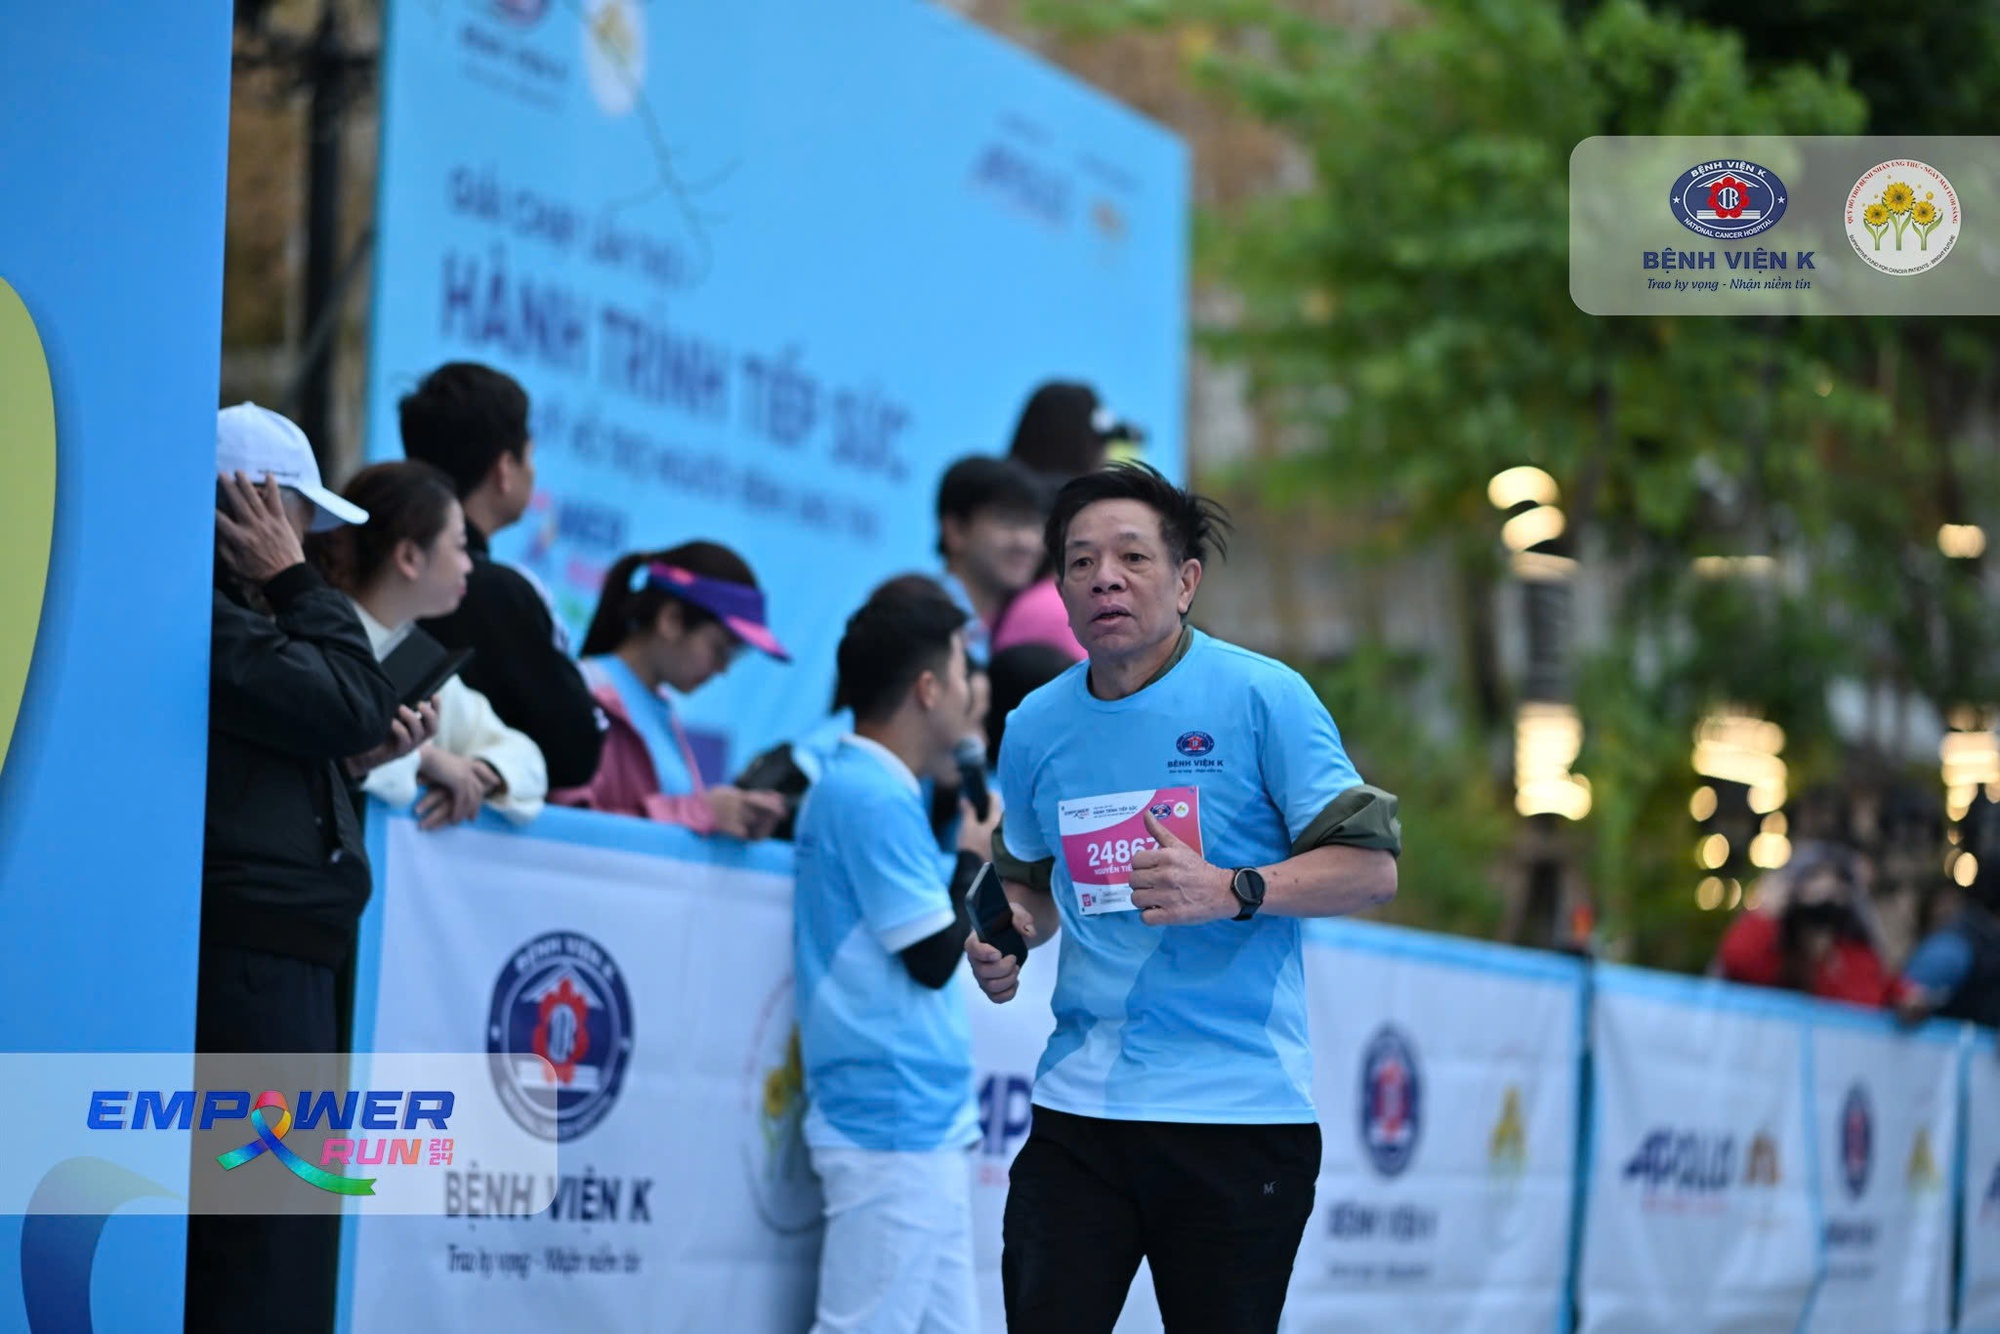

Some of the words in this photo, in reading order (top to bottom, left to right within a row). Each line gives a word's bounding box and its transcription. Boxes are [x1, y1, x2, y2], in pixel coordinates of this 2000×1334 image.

[1120, 863, 1134, 872] TIẾ
[445, 1161, 534, 1232] BỆNH
[546, 1164, 621, 1234] VIỆN
[630, 1177, 655, 1224] K
